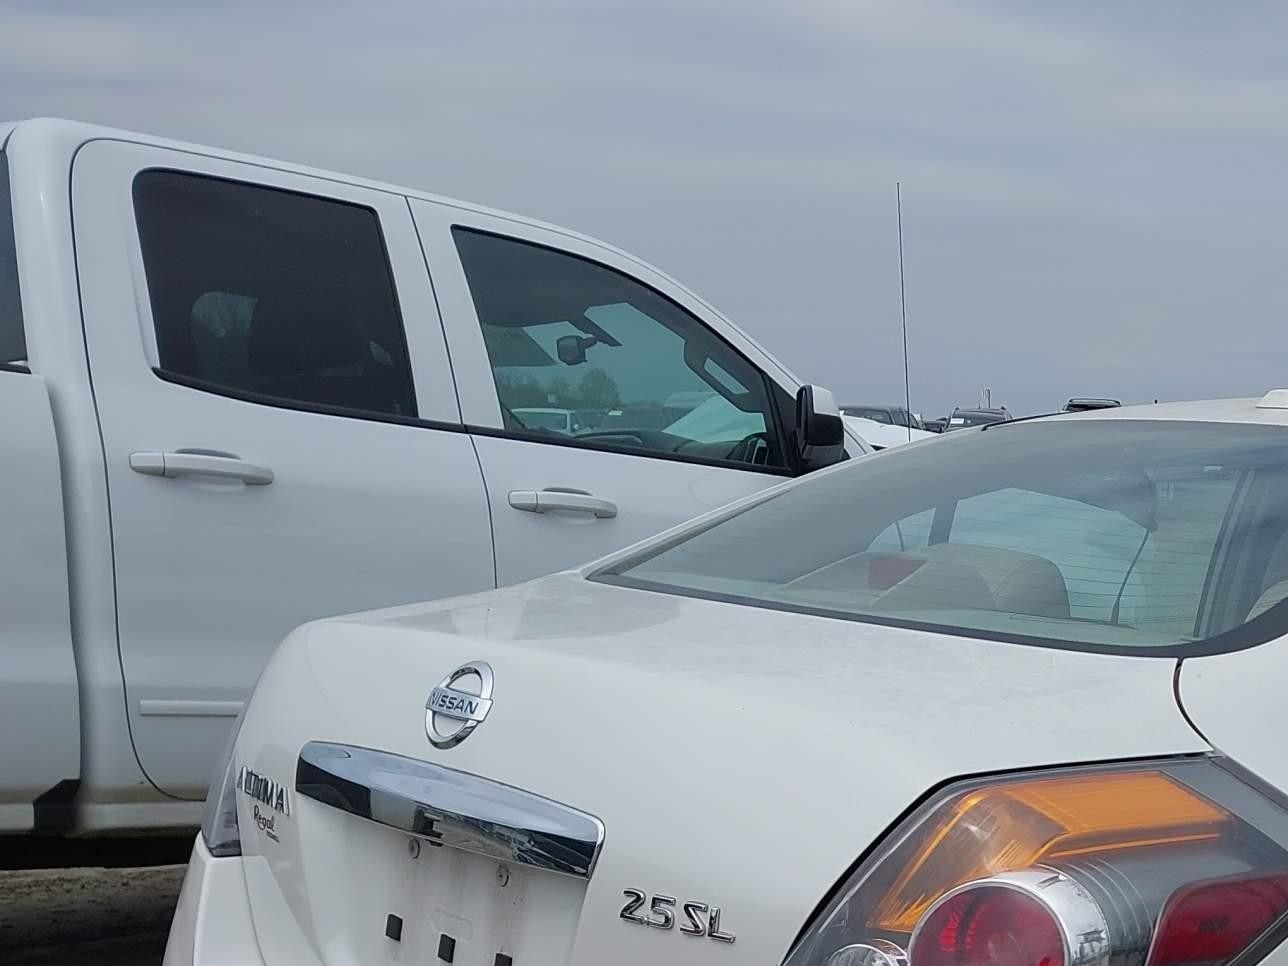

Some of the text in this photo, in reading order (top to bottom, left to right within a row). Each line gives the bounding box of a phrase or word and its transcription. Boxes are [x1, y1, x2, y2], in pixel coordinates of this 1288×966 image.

[430, 691, 479, 715] NISSAN
[237, 766, 290, 817] ALTIMA
[619, 888, 736, 944] 2.5 SL
